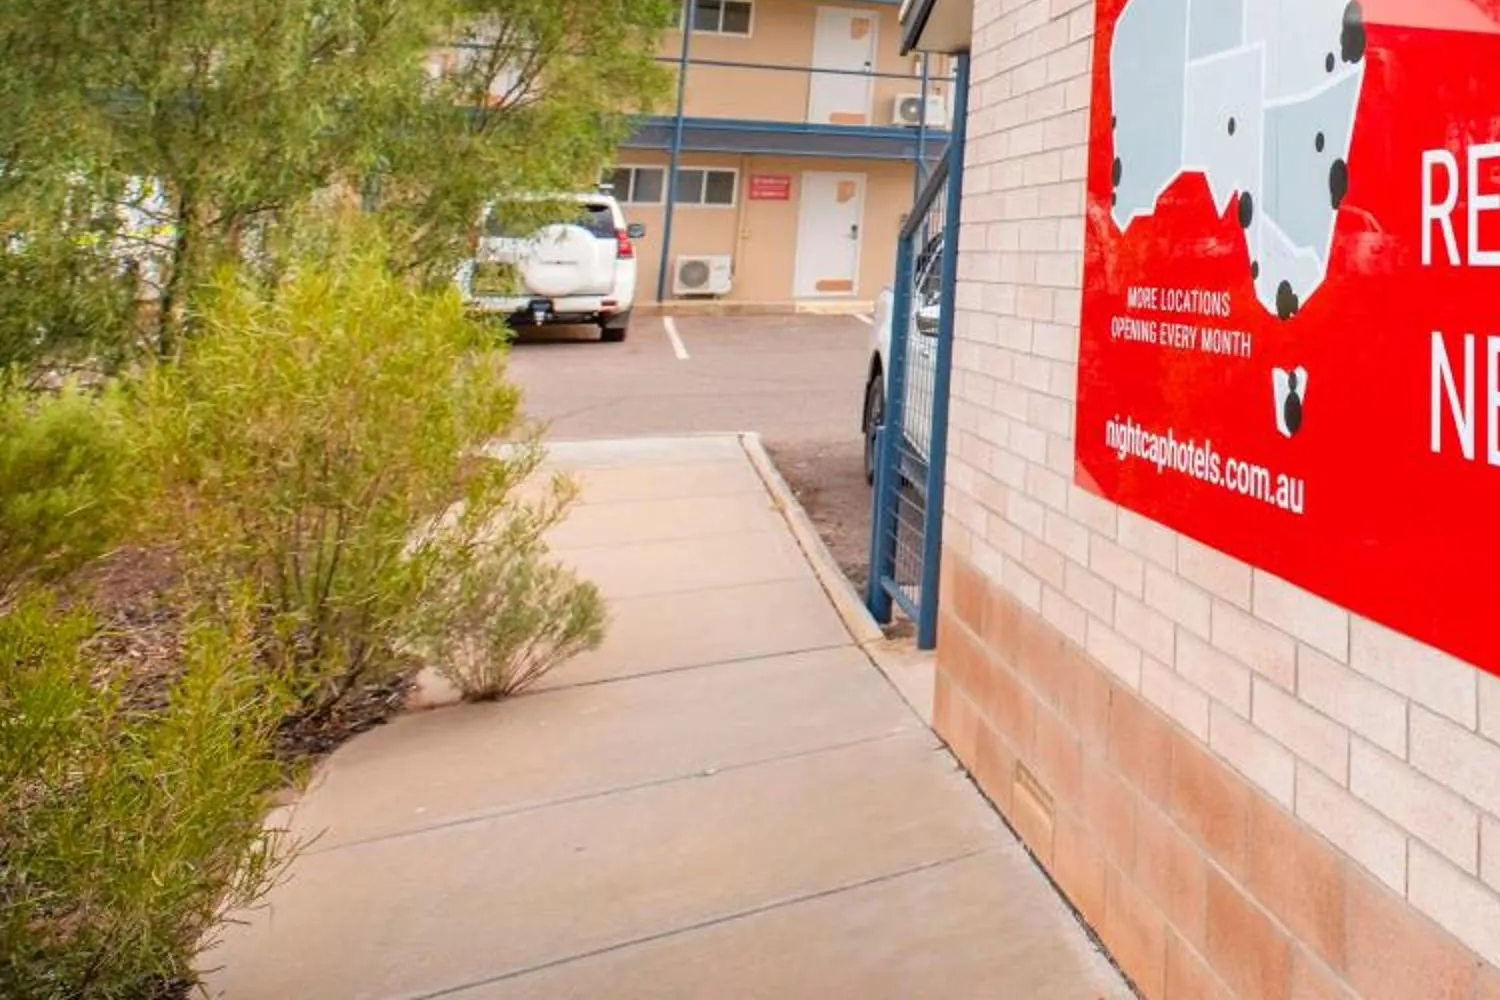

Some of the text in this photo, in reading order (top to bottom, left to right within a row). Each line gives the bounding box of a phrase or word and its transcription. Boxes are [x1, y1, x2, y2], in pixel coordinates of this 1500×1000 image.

[1127, 285, 1232, 318] MORE LOCATIONS
[1110, 315, 1252, 359] OPENING EVERY MONTH
[1105, 413, 1304, 515] nightcaphotels.com.au
